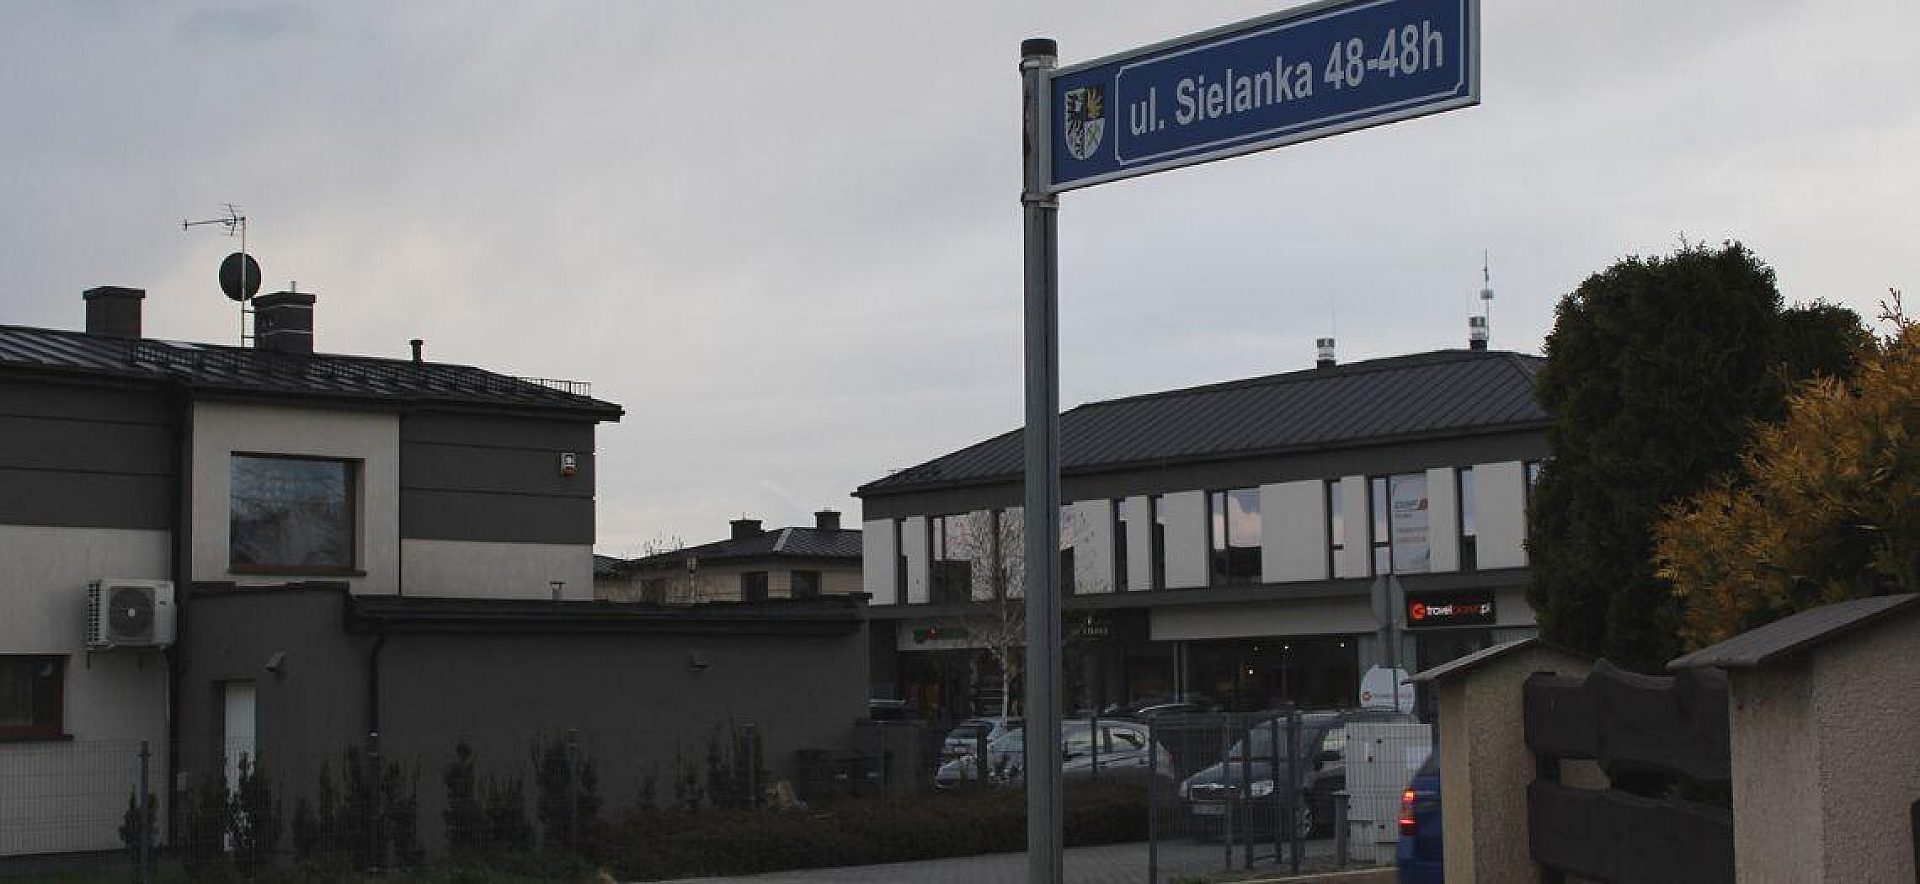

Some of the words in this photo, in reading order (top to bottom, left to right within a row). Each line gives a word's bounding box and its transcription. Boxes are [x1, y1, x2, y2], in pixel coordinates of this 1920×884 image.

[1130, 87, 1165, 135] ul.
[1175, 56, 1313, 125] Sielanka
[1324, 20, 1443, 90] 48-48h
